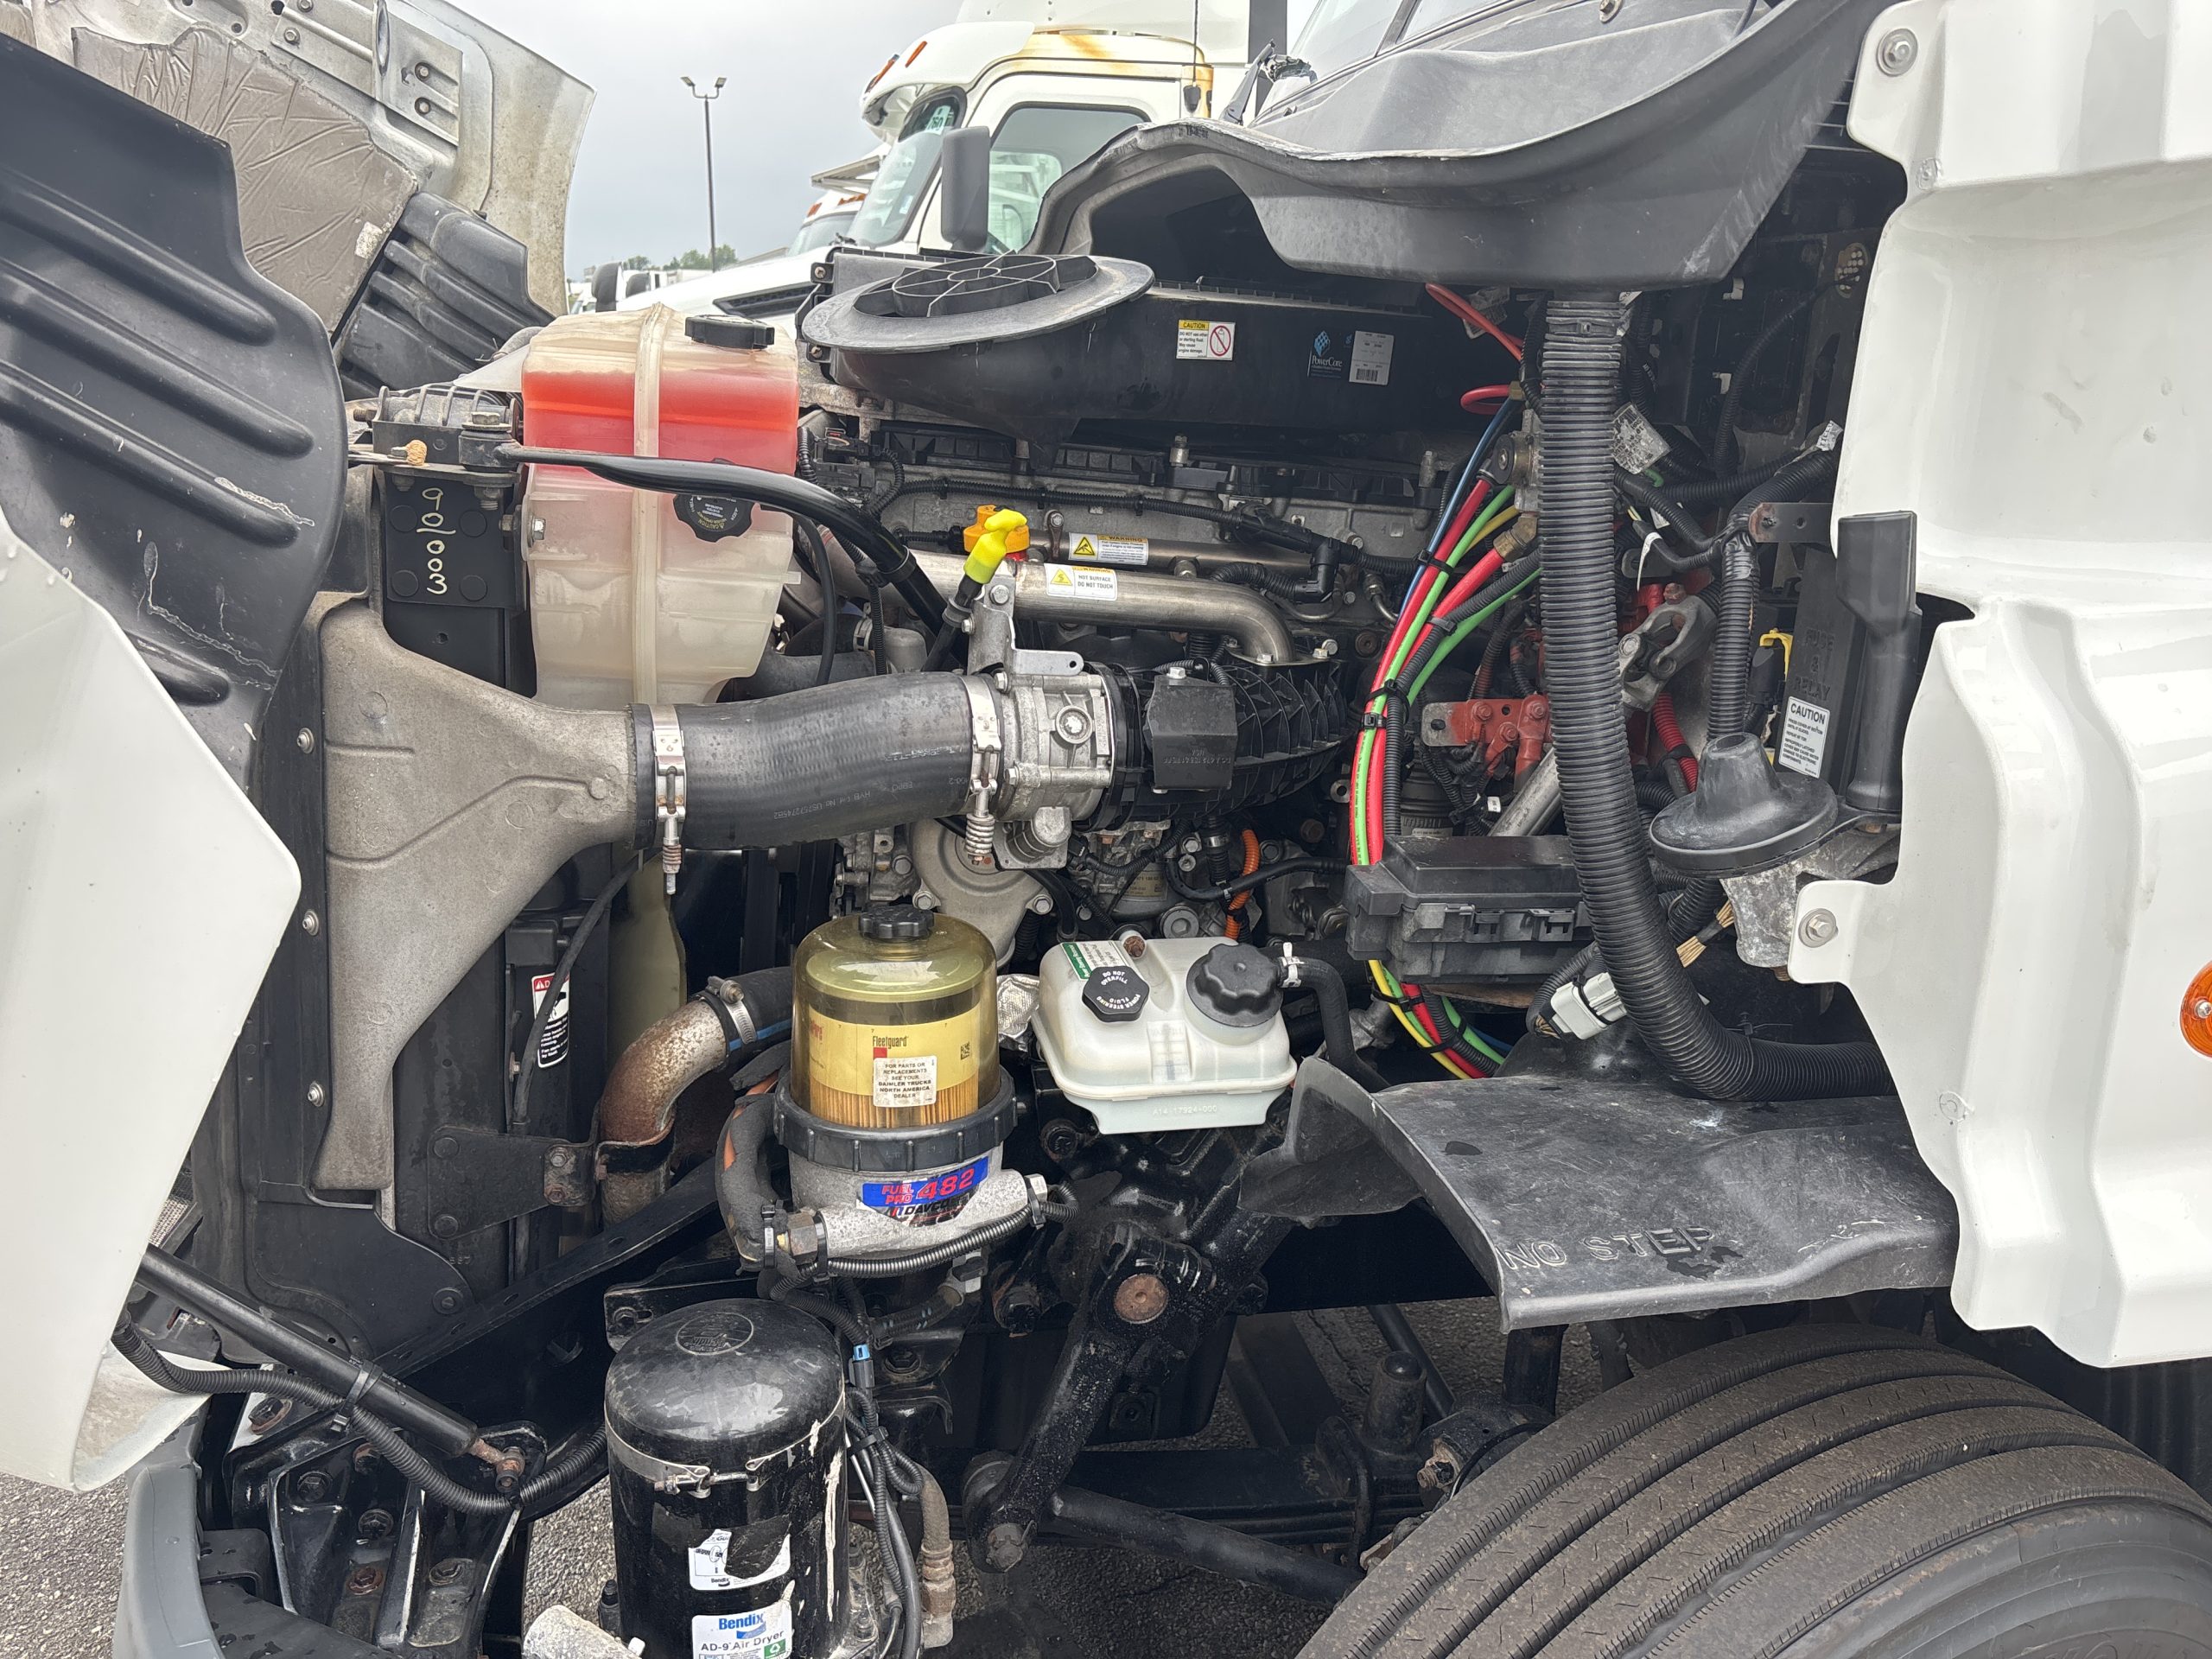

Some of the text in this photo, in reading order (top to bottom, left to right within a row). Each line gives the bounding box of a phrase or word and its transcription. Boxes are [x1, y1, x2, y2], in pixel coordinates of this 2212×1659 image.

[1313, 355, 1342, 367] PowerCore
[698, 518, 719, 530] CAUTION
[1790, 702, 1826, 725] CAUTION
[1101, 976, 1128, 986] OVERFILL
[1096, 994, 1141, 1009] POWER STEERING
[872, 1036, 907, 1050] Fleetguard
[881, 1183, 915, 1196] FUEL
[916, 1167, 976, 1200] 482
[885, 1193, 914, 1205] PRO
[1495, 1225, 1714, 1270] NO STEP
[718, 1612, 765, 1631] Bendix
[701, 1630, 785, 1652] AD-9 Air Dryer
